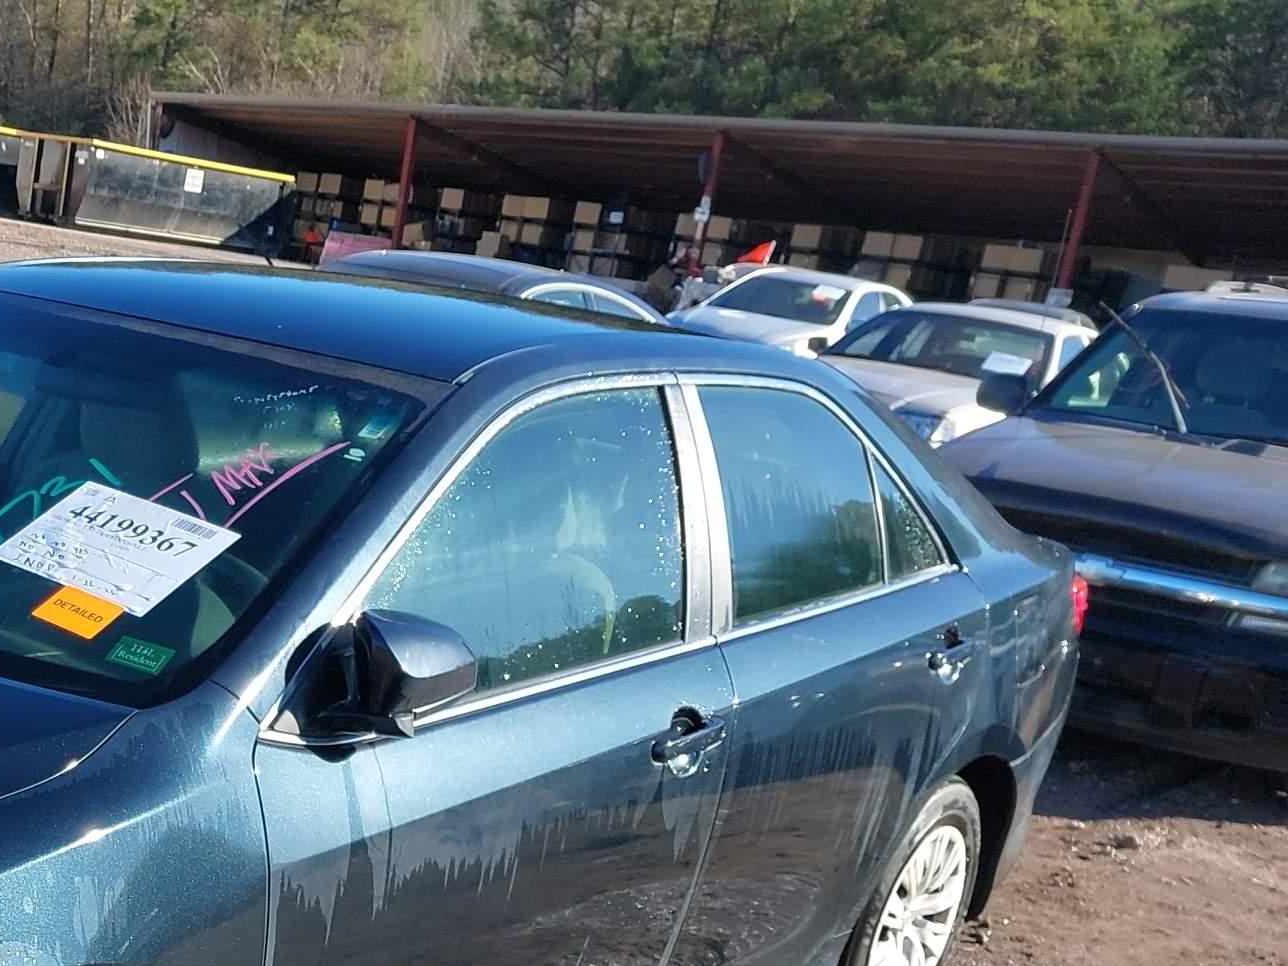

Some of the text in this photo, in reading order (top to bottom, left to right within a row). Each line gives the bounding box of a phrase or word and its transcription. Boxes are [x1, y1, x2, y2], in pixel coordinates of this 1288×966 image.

[69, 505, 199, 558] 44199367
[53, 598, 105, 624] DETAILED
[117, 650, 158, 668] Resident
